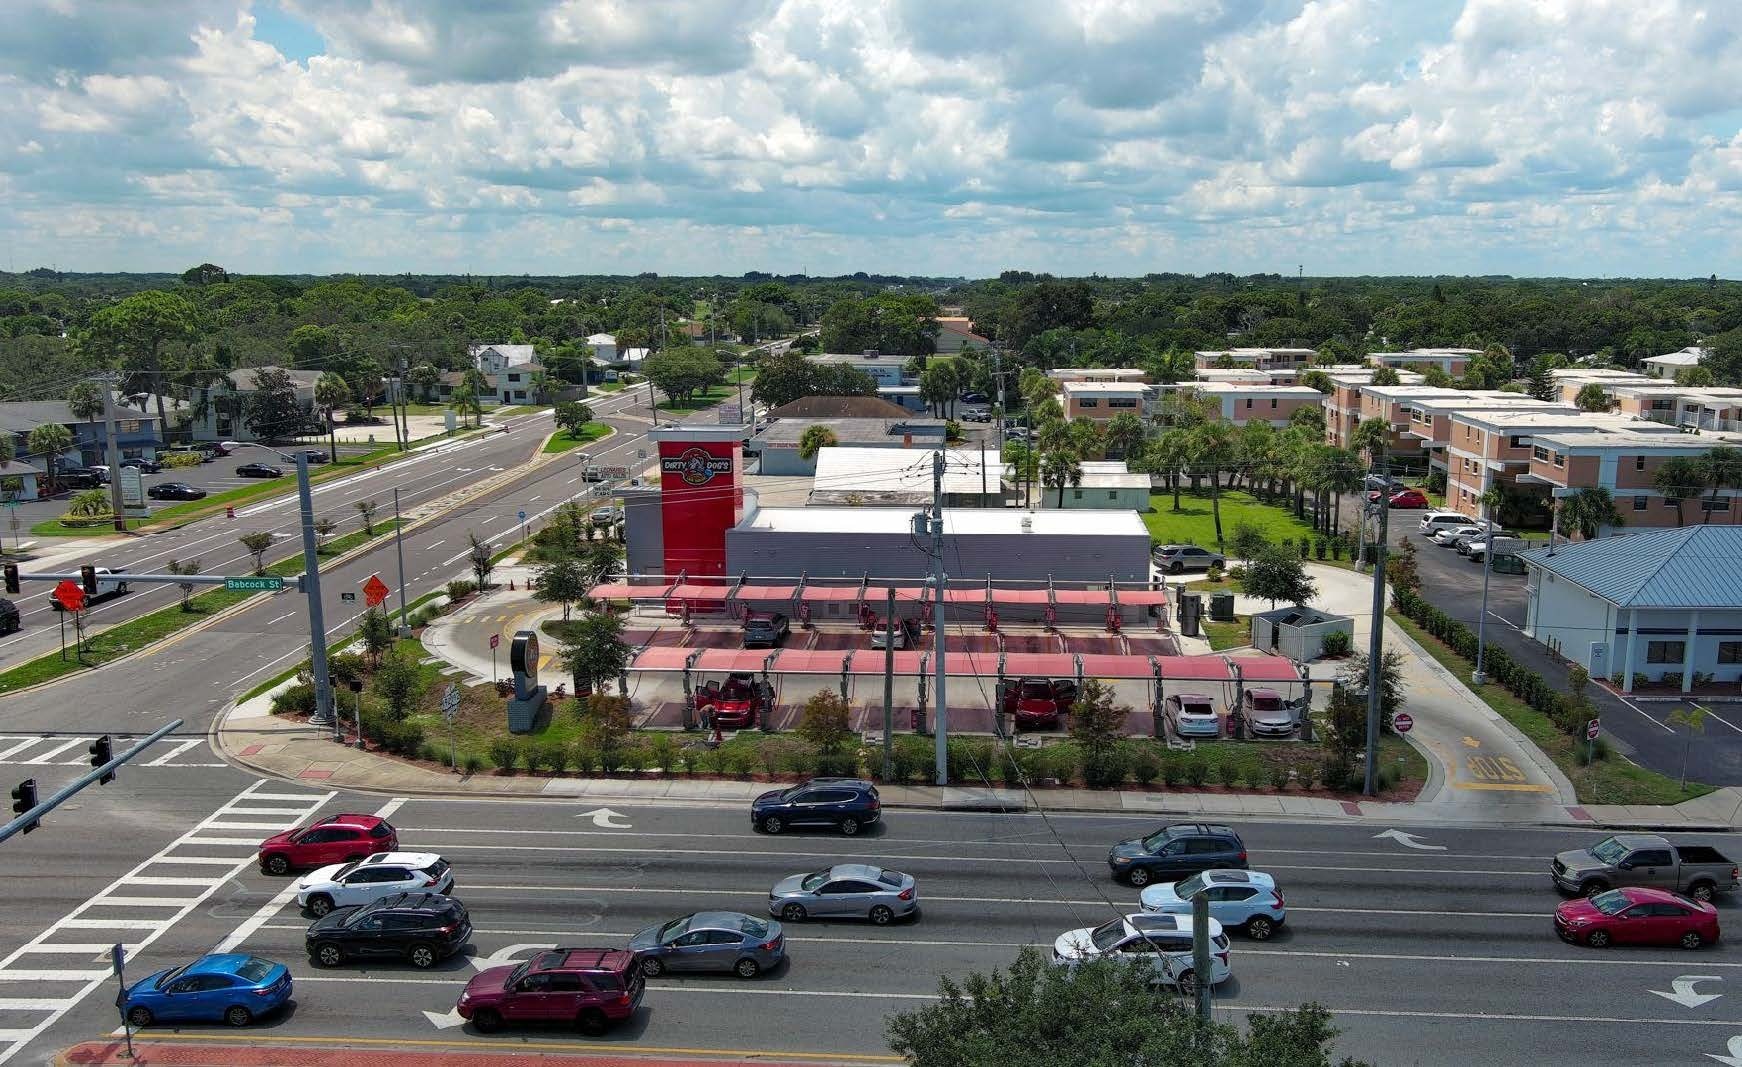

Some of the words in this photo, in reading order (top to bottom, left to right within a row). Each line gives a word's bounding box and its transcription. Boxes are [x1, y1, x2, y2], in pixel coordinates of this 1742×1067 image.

[664, 461, 687, 469] DIRTY
[706, 461, 729, 470] DOG'S
[228, 581, 266, 589] Babcock
[269, 580, 280, 589] St
[1466, 756, 1527, 780] STOP
